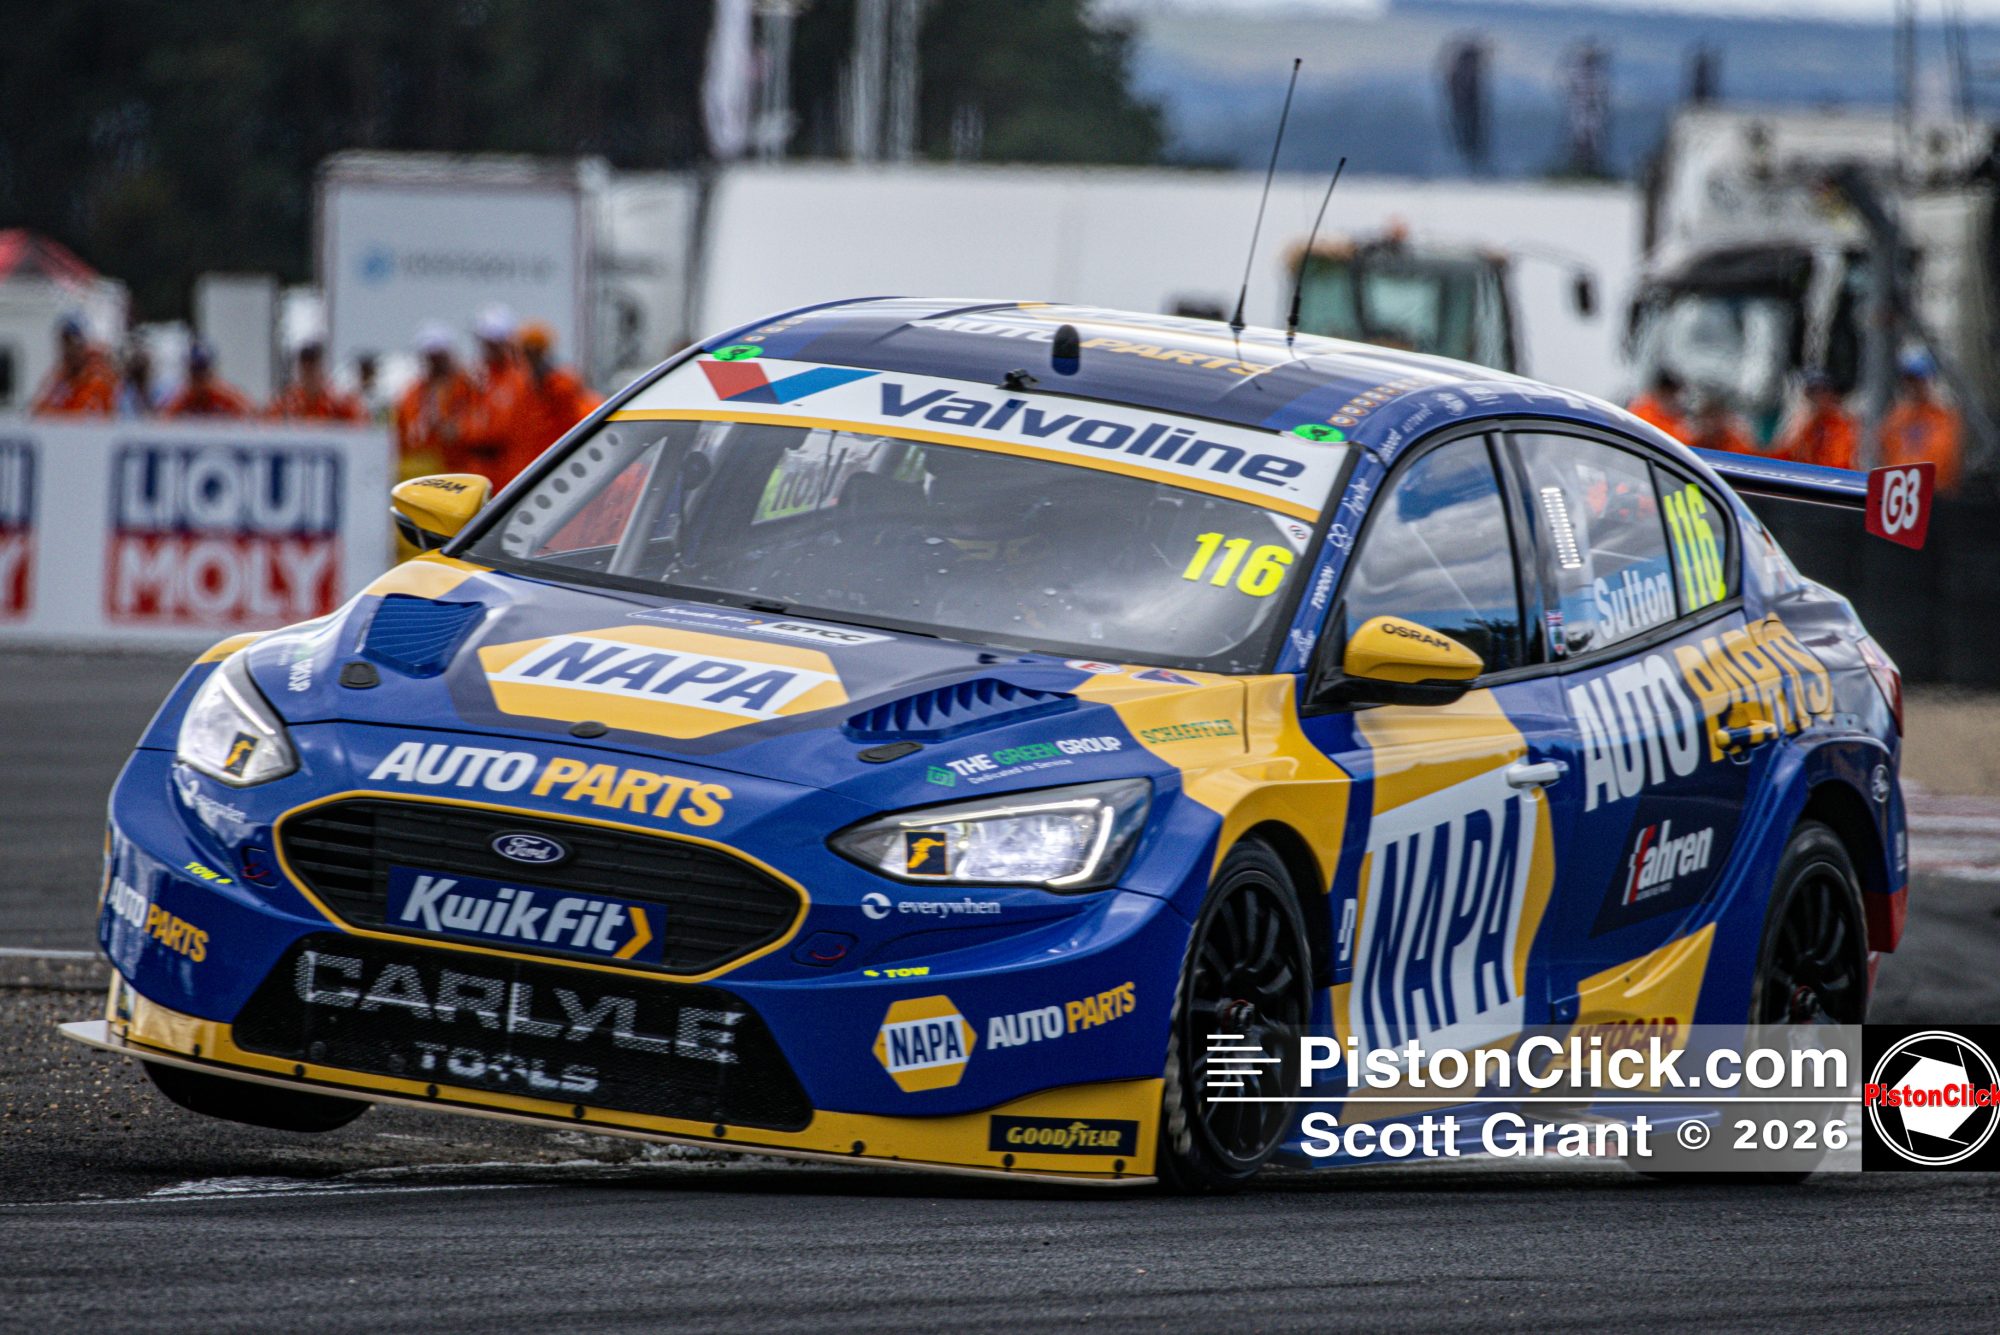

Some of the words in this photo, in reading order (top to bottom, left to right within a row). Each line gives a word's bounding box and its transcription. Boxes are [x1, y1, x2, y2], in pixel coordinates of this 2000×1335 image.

[1081, 338, 1275, 376] PARTS
[881, 383, 1306, 488] Valvoline
[121, 450, 334, 525] LIQUI
[119, 542, 334, 616] MOLY
[1182, 532, 1294, 597] 116
[1664, 484, 1727, 611] 116
[1381, 623, 1451, 652] OSRAM
[1593, 570, 1674, 639] Sutton
[520, 641, 798, 711] NAPA
[1568, 654, 1700, 813] AUTO
[1674, 612, 1834, 763] PARTS
[368, 742, 538, 792] AUTO
[531, 757, 733, 827] PARTS
[946, 754, 998, 776] THE
[993, 743, 1063, 766] GREEN
[1055, 736, 1122, 755] GROUP
[184, 861, 221, 880] TOW
[505, 837, 552, 859] Ford
[1621, 819, 1714, 906] fahren
[107, 876, 148, 928] AUTO
[144, 902, 209, 962] PARTS
[898, 897, 1001, 919] everywhen
[1361, 793, 1521, 1056] NAPA
[883, 966, 930, 978] TOW
[293, 950, 748, 1064] CARLYLE
[987, 1006, 1063, 1050] AUTO
[1066, 981, 1137, 1033] PARTS
[892, 1020, 962, 1067] NAPA
[1006, 1125, 1122, 1148] GOODYEAR
